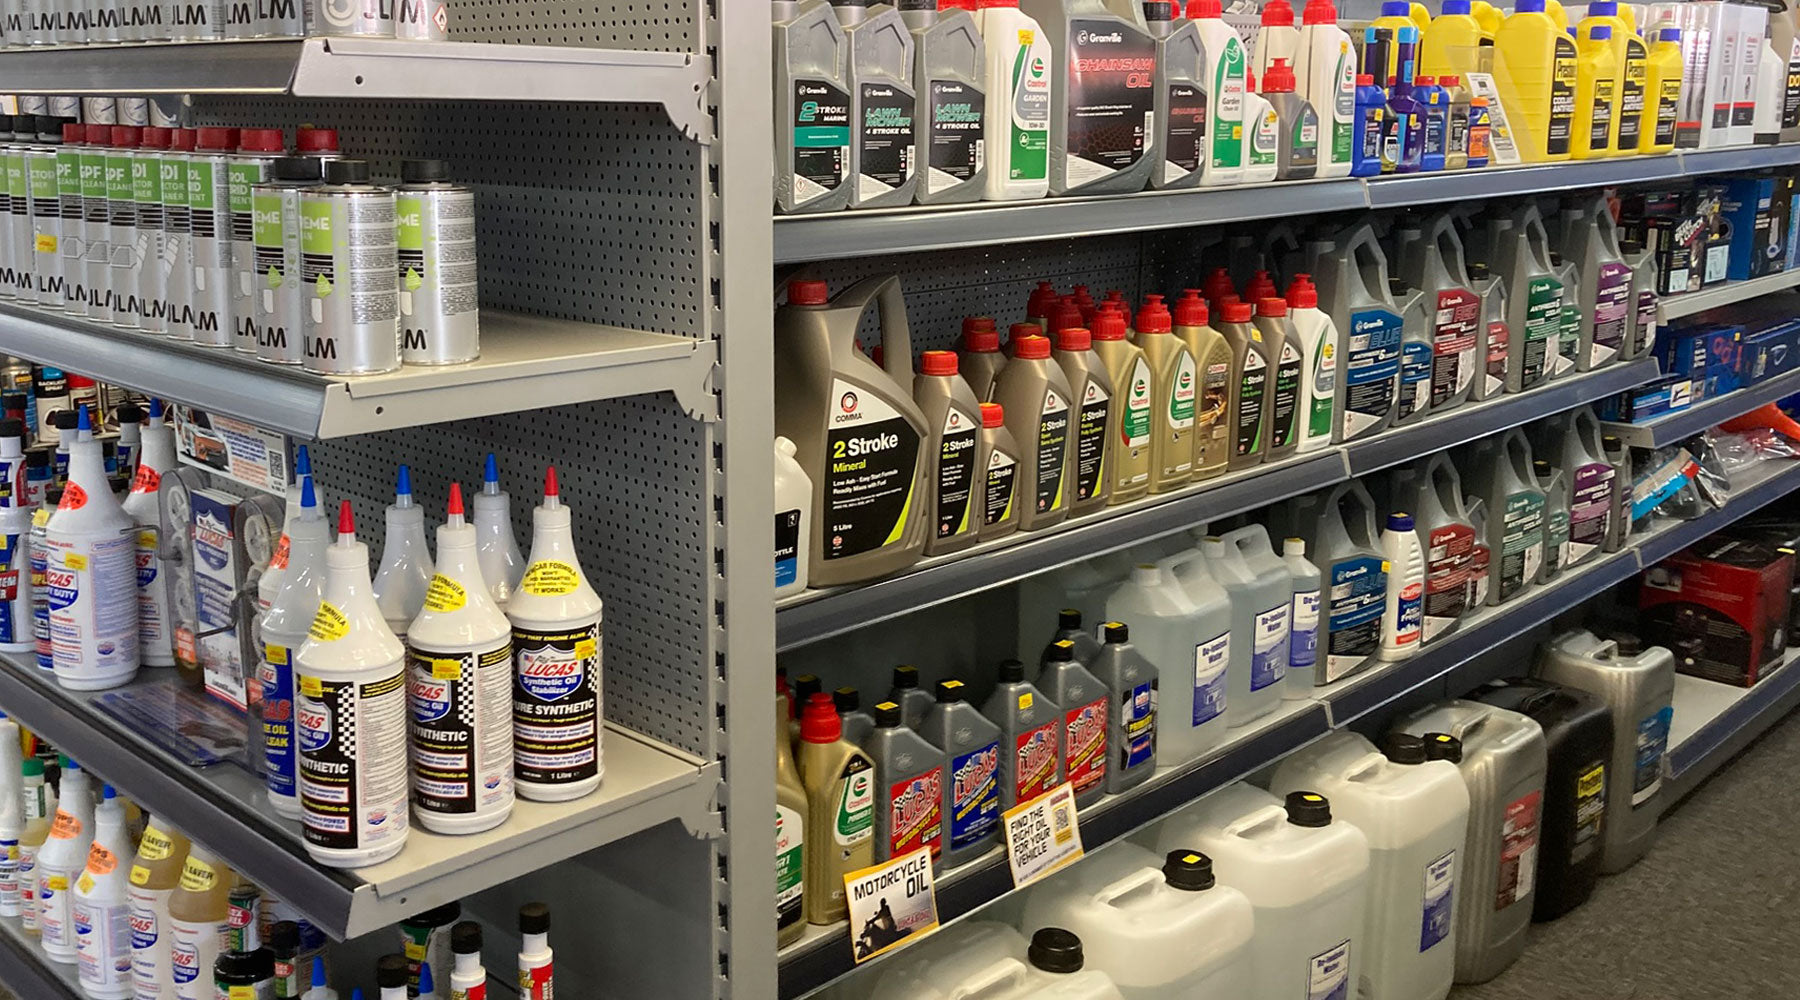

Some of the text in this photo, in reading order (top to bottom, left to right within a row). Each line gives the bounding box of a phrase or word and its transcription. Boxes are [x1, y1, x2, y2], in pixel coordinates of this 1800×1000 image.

[1089, 32, 1123, 44] Granville
[1076, 57, 1154, 72] CHAINSAW
[1027, 79, 1047, 88] Castrol
[1125, 72, 1153, 88] OIL
[799, 101, 847, 122] 2 STROKE
[871, 127, 900, 135] STROKE
[835, 412, 863, 423] COMMA
[1081, 408, 1106, 422] 2 Stroke
[1041, 418, 1066, 432] 2 Stroke
[833, 432, 899, 459] 2 Stroke
[943, 438, 975, 452] 2 Stroke
[833, 459, 867, 474] Mineral
[993, 468, 1012, 479] Stroke
[523, 661, 578, 677] LUCAS
[523, 676, 578, 687] Synthetic Oil
[514, 698, 595, 715] URE SYNTHETIC
[952, 744, 998, 808] LUCAS
[1010, 805, 1044, 834] FIND THE
[1012, 818, 1048, 845] RIGHT OIL
[1014, 827, 1051, 858] FOR YOUR
[1015, 841, 1048, 869] VEHICLE
[854, 854, 927, 901] MOTORCYCLE
[906, 872, 929, 899] OIL
